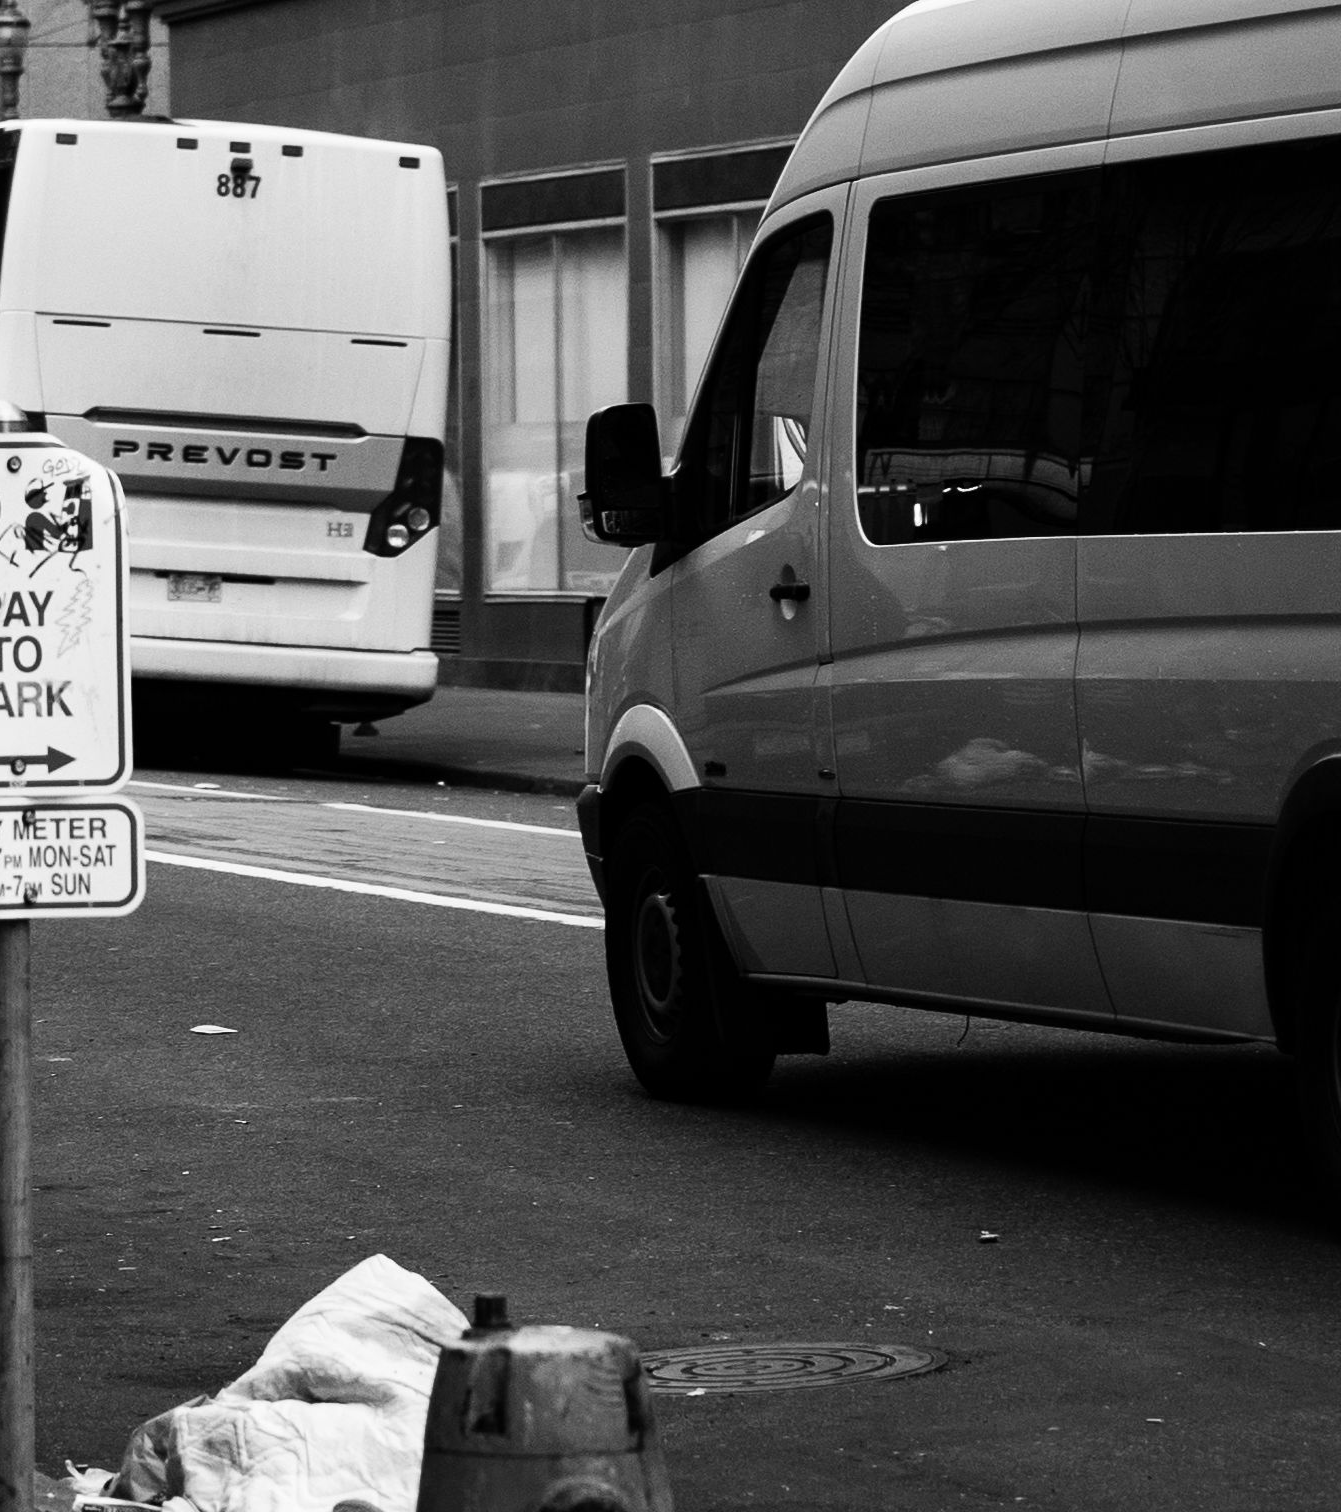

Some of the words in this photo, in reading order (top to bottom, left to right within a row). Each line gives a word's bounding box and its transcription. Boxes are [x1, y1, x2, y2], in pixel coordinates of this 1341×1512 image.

[216, 174, 262, 199] 887
[113, 441, 338, 472] PREVOST
[13, 817, 107, 841] METER
[28, 844, 117, 869] MON-SAT
[51, 872, 92, 896] SUN
